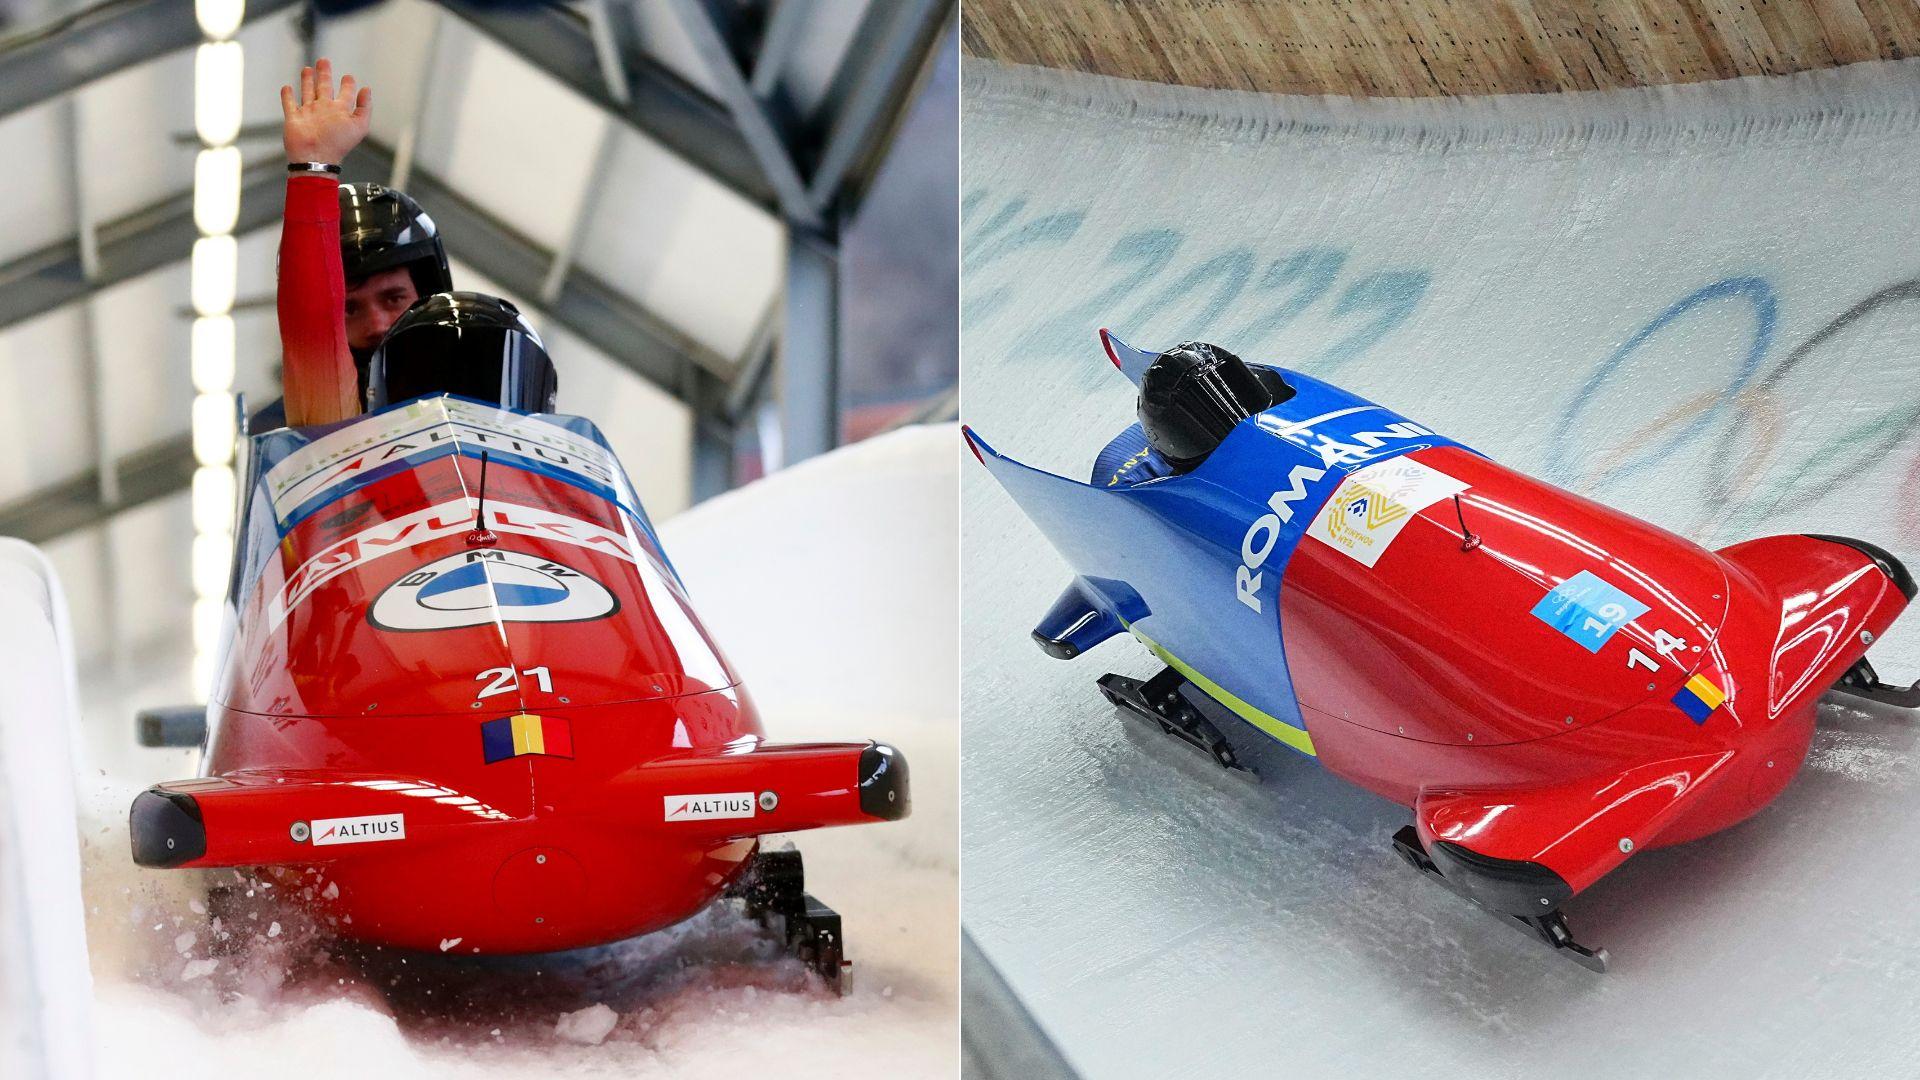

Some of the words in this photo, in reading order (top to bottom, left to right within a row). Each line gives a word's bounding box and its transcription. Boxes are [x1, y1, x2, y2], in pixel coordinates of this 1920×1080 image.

[381, 429, 612, 483] ALTIUS
[397, 551, 580, 587] BMW
[1582, 603, 1627, 638] 19
[1626, 628, 1688, 673] 14
[475, 666, 553, 699] 21
[692, 799, 750, 813] ALTIUS
[339, 820, 399, 837] ALTIUS
